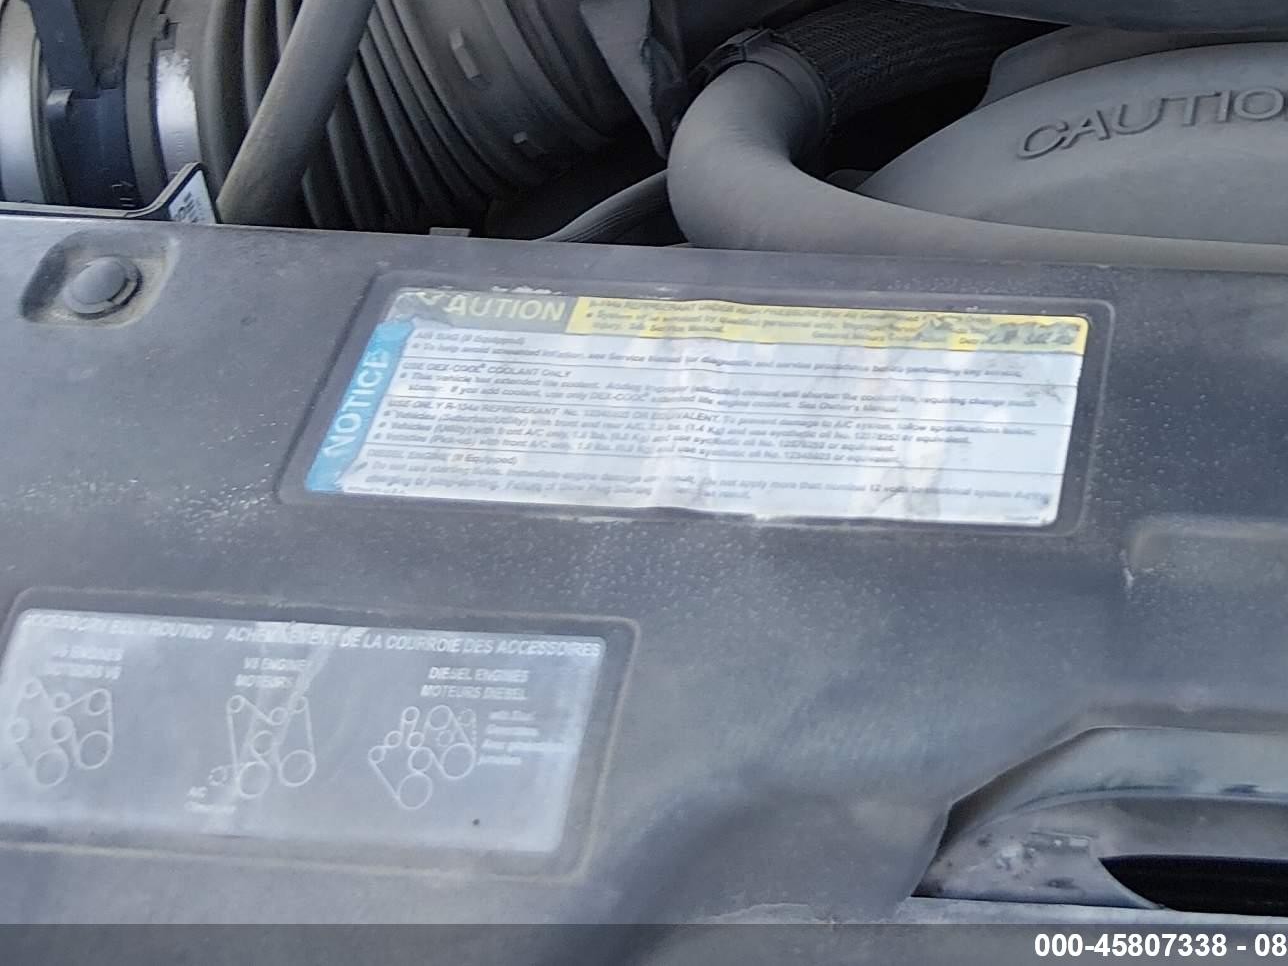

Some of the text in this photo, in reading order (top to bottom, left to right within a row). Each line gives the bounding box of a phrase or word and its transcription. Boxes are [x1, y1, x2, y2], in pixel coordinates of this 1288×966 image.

[438, 292, 567, 322] AUTION
[324, 349, 389, 458] NOTICE
[150, 620, 214, 639] ROUTING
[363, 634, 384, 649] LA
[461, 639, 494, 654] DES
[495, 639, 601, 657] ACCESSOIRES
